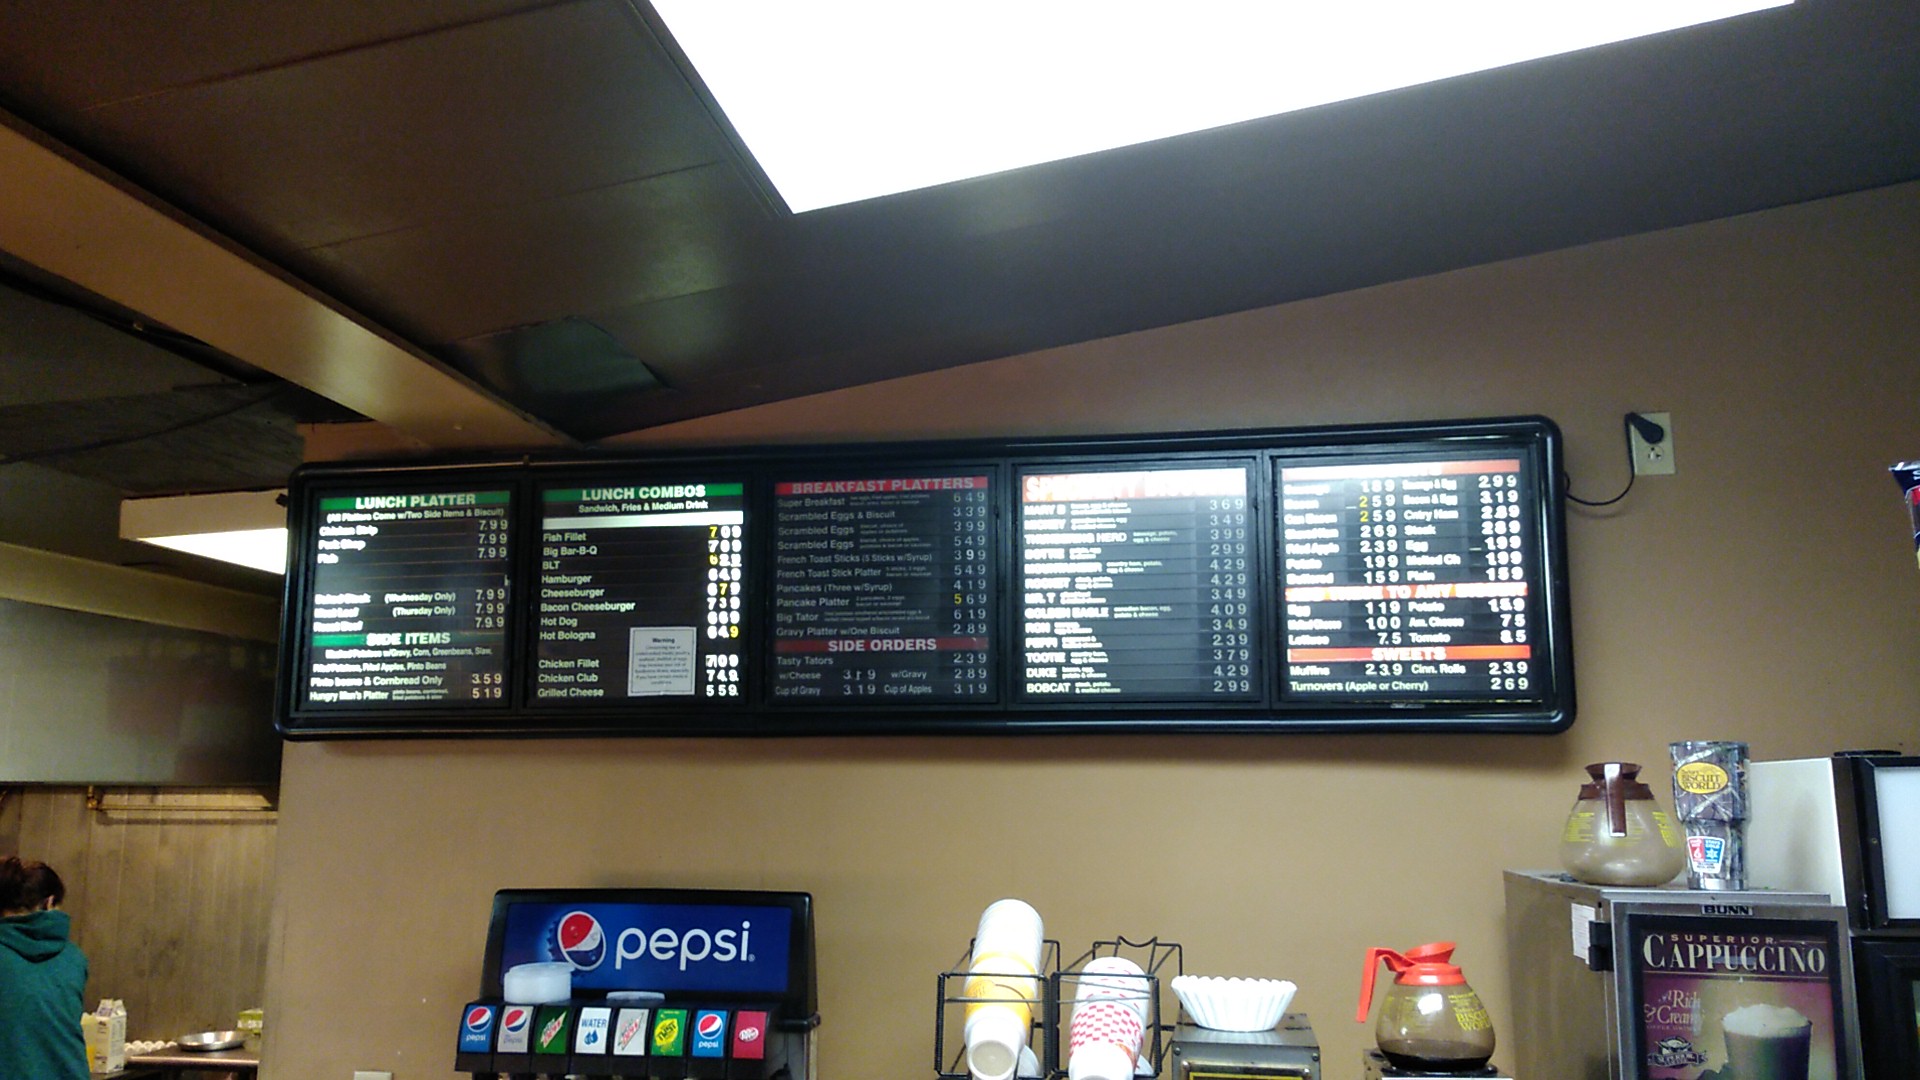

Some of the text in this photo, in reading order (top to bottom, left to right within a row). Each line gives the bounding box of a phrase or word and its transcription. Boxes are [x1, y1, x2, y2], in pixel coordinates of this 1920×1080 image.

[792, 477, 974, 495] BREAKFAST PLATTERS
[582, 484, 706, 501] LUNCH COMBOS
[355, 494, 476, 510] LUNCH PLATTER
[578, 500, 709, 513] Sandwich, Fries & Medium Drink
[777, 499, 803, 509] Super
[804, 497, 846, 507] Breakfast
[372, 511, 397, 520] Come
[397, 510, 423, 519] w/Two
[424, 509, 442, 518] Side
[443, 508, 465, 517] Items
[466, 508, 472, 517] &
[778, 510, 896, 522] Scrambled Eggs & Biscuit
[778, 526, 828, 536] Scrambled
[830, 525, 855, 536] Eggs
[543, 532, 587, 542] Fish Fillet
[778, 541, 828, 550] Scrambled
[830, 540, 854, 550] Eggs
[543, 546, 598, 557] Big Bar-B-Q
[777, 555, 807, 564] French
[809, 554, 832, 563] Toast
[833, 554, 860, 562] Sticks
[871, 553, 896, 562] Sticks
[897, 552, 933, 563] w/Syrup)
[542, 561, 560, 570] BLT
[776, 569, 805, 579] French
[807, 569, 830, 578] Toast
[831, 568, 853, 577] Stick
[854, 568, 882, 577] Platter
[541, 575, 592, 586] Hamburger
[541, 587, 605, 599] Cheeseburger
[776, 582, 893, 593] Pancakes (Three w/Syrup)
[1386, 585, 1412, 599] TO
[384, 592, 433, 604] (Wednesday
[434, 592, 456, 603] Only)
[776, 598, 817, 608] Pancake
[818, 597, 850, 607] Platter
[392, 607, 433, 618] (Thursday
[434, 606, 456, 617] Only)
[540, 601, 636, 613] Bacon Cheeseburger
[540, 617, 578, 627] Hot Dog
[776, 613, 793, 623] Big
[795, 613, 819, 622] Tator
[540, 631, 596, 641] Hot Bologna
[776, 626, 901, 638] Gravy Platter w/One Biscuit
[1408, 632, 1451, 643] Tomato
[366, 631, 451, 647] SIDE ITEMS
[652, 636, 676, 645] Warning
[827, 638, 937, 652] SIDE ORDERS
[1372, 647, 1447, 662] SWEETS
[538, 659, 600, 669] Chicken Fillet
[776, 656, 834, 666] Tasty Tators
[779, 670, 927, 680] w/Cheese w/Gravy
[1289, 663, 1466, 677] Muffins Cinn. Rolls
[363, 676, 372, 687] &
[373, 675, 420, 687] Cornbread
[421, 675, 443, 687] Only
[538, 673, 599, 684] Chicken Club
[775, 684, 932, 696] Cup of Gravy Cup of Apples
[1026, 682, 1071, 694] BOBCAT
[1289, 680, 1344, 692] Turnovers
[1345, 680, 1377, 693] (Apple
[1378, 682, 1390, 691] or
[1391, 680, 1429, 693] Cherry)
[309, 691, 339, 703] Hungry
[363, 690, 390, 701] Platter
[537, 687, 604, 698] Grilled Cheese
[1682, 782, 1721, 790] WORLD
[1704, 905, 1750, 916] BUNN
[1671, 934, 1775, 944] SUPERIOR
[615, 920, 750, 971] pepsi
[1643, 933, 1826, 973] CAPPUCCINO
[581, 1018, 607, 1028] WATER
[465, 1033, 486, 1042] pepsi
[698, 1041, 719, 1049] pepsi
